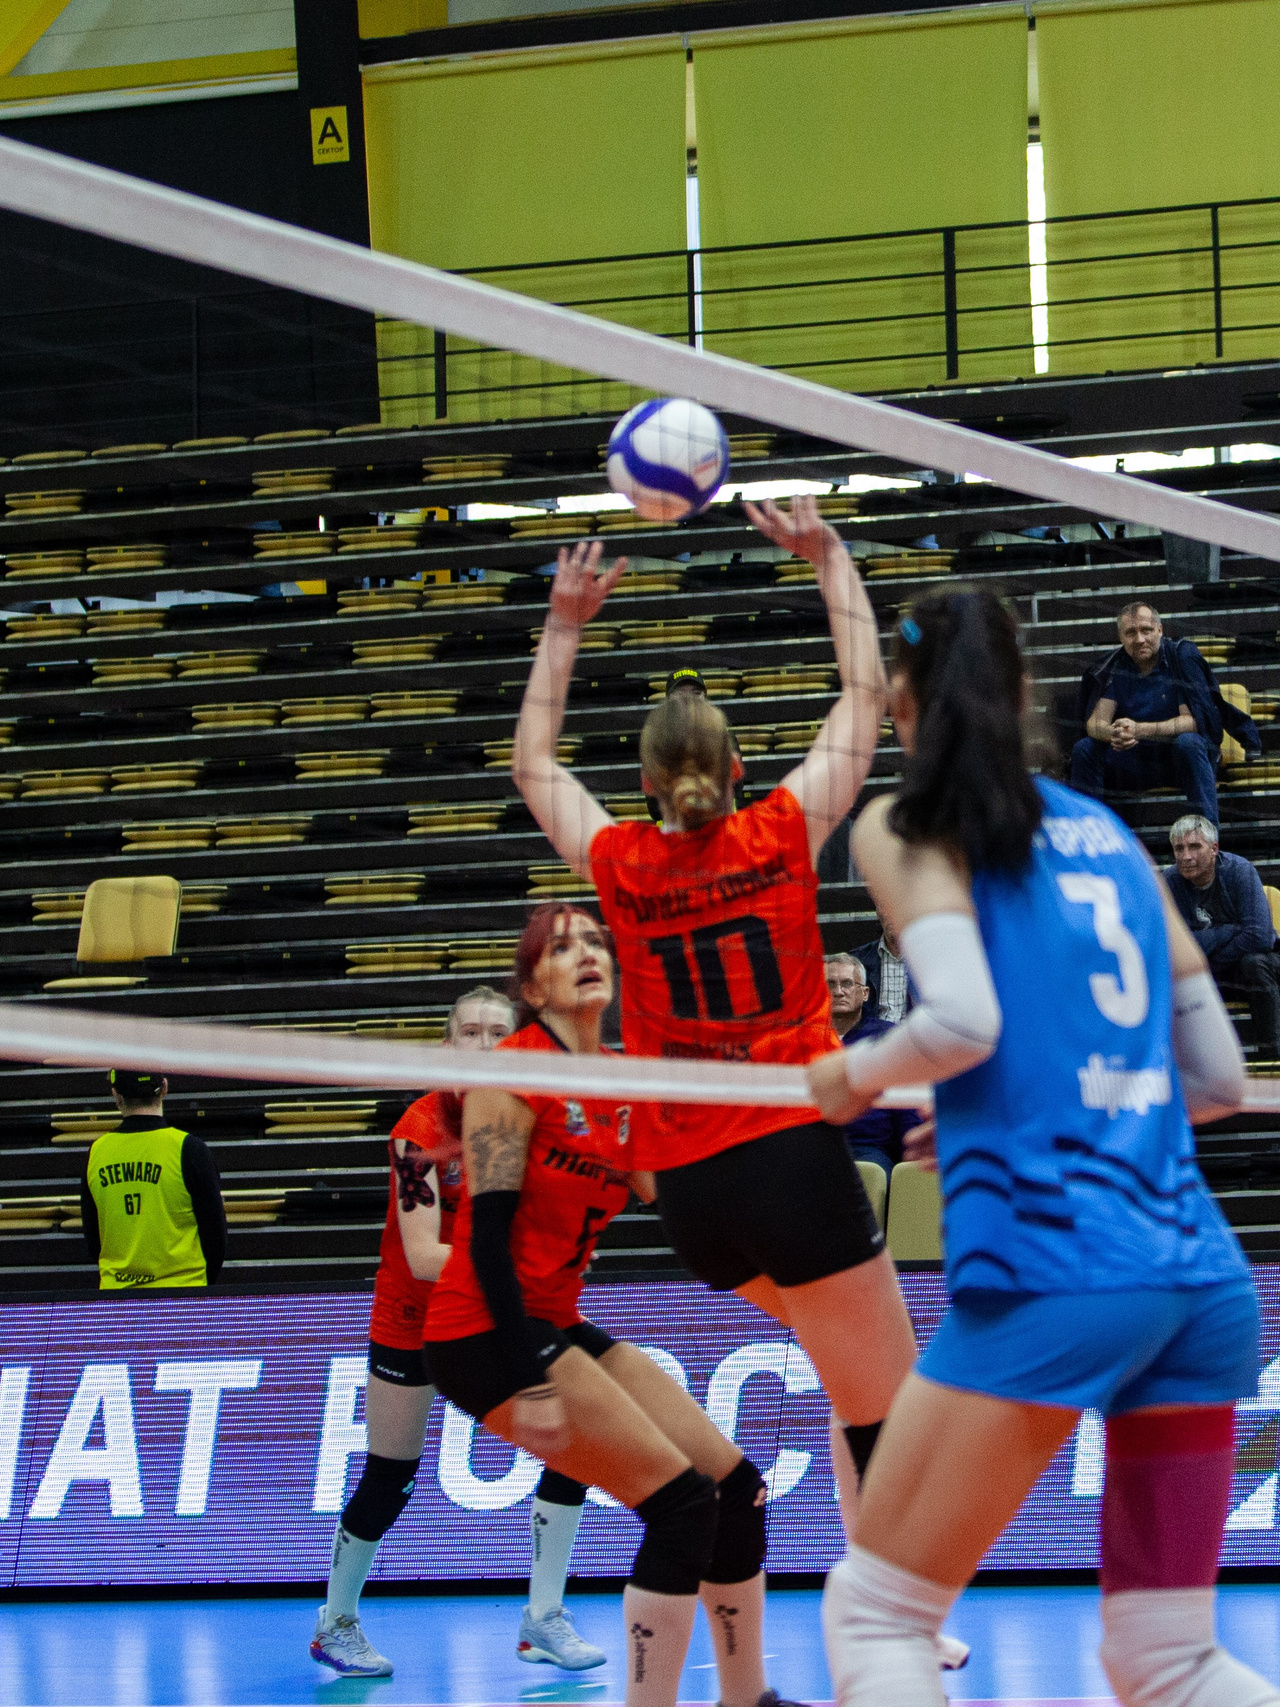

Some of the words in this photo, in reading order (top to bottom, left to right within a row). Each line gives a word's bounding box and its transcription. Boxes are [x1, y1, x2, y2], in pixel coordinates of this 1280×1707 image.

[317, 146, 344, 156] СЕКТОР
[1056, 874, 1150, 1029] 3
[649, 914, 784, 1022] 10
[99, 1161, 162, 1187] STEWARD
[124, 1193, 141, 1215] 67
